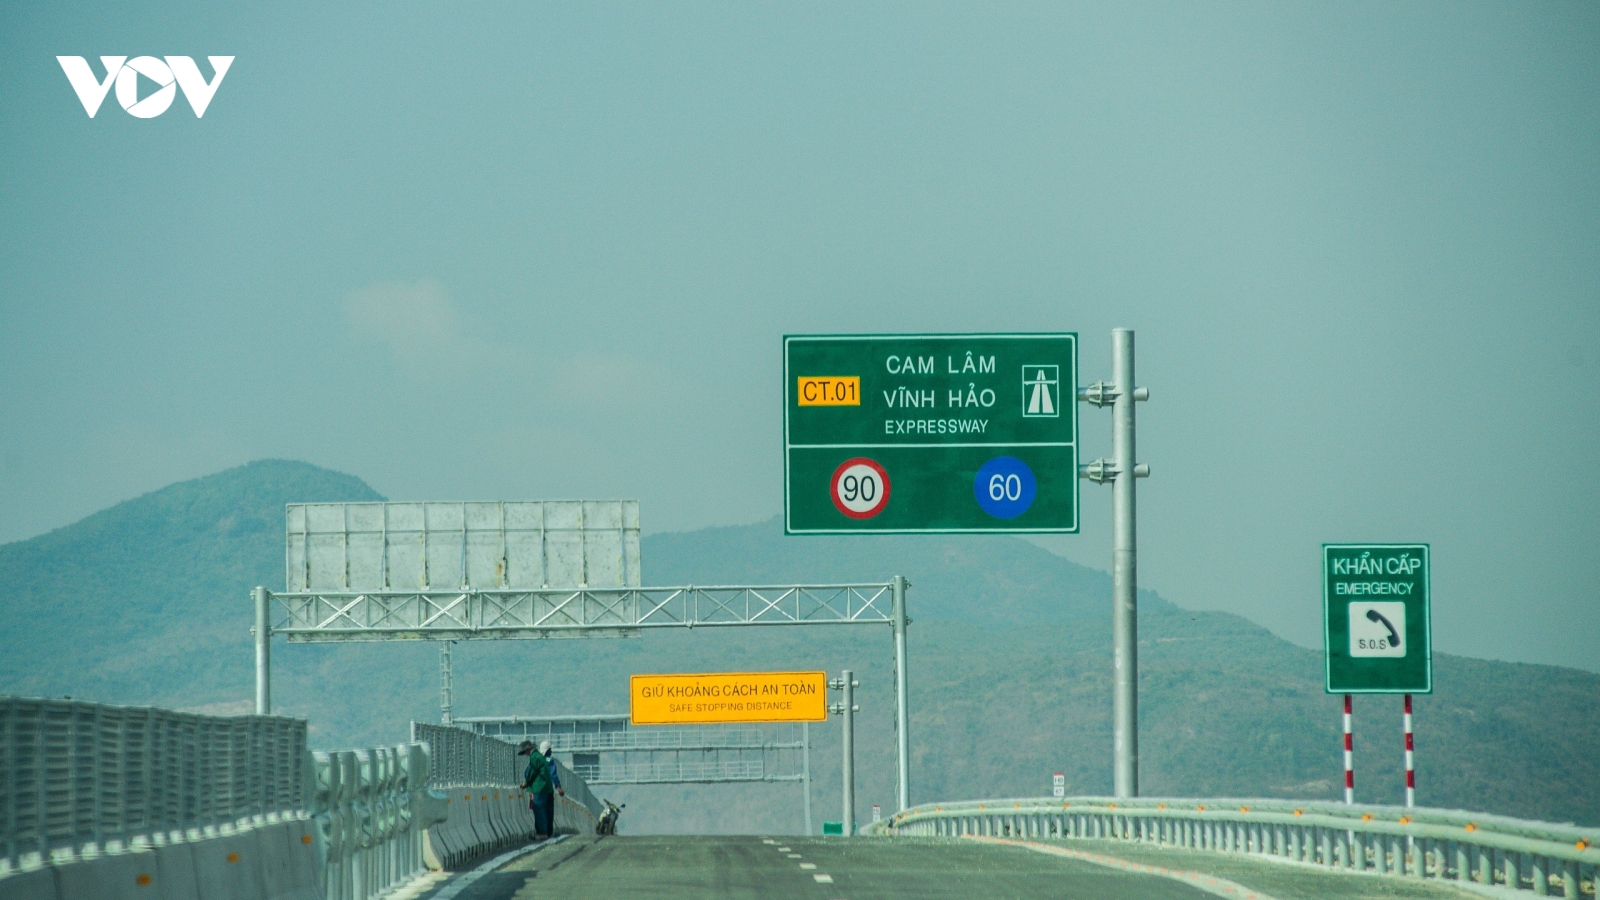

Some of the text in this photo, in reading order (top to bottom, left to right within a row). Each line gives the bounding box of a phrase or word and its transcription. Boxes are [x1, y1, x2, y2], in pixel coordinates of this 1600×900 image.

[886, 351, 996, 374] CAM LÂM
[803, 381, 857, 402] CT.01
[883, 383, 996, 408] VĨNH HẢO
[885, 419, 989, 434] EXPRESSWAY
[843, 475, 876, 502] 90
[988, 474, 1022, 501] 60
[1334, 551, 1421, 575] KHẨN CẤP
[1336, 582, 1414, 595] EMERGENCY
[642, 680, 816, 698] GIỮ KHOẢNG CÁCH AN TOÀN
[669, 701, 793, 713] SAFE STOPPING DISTANCE
